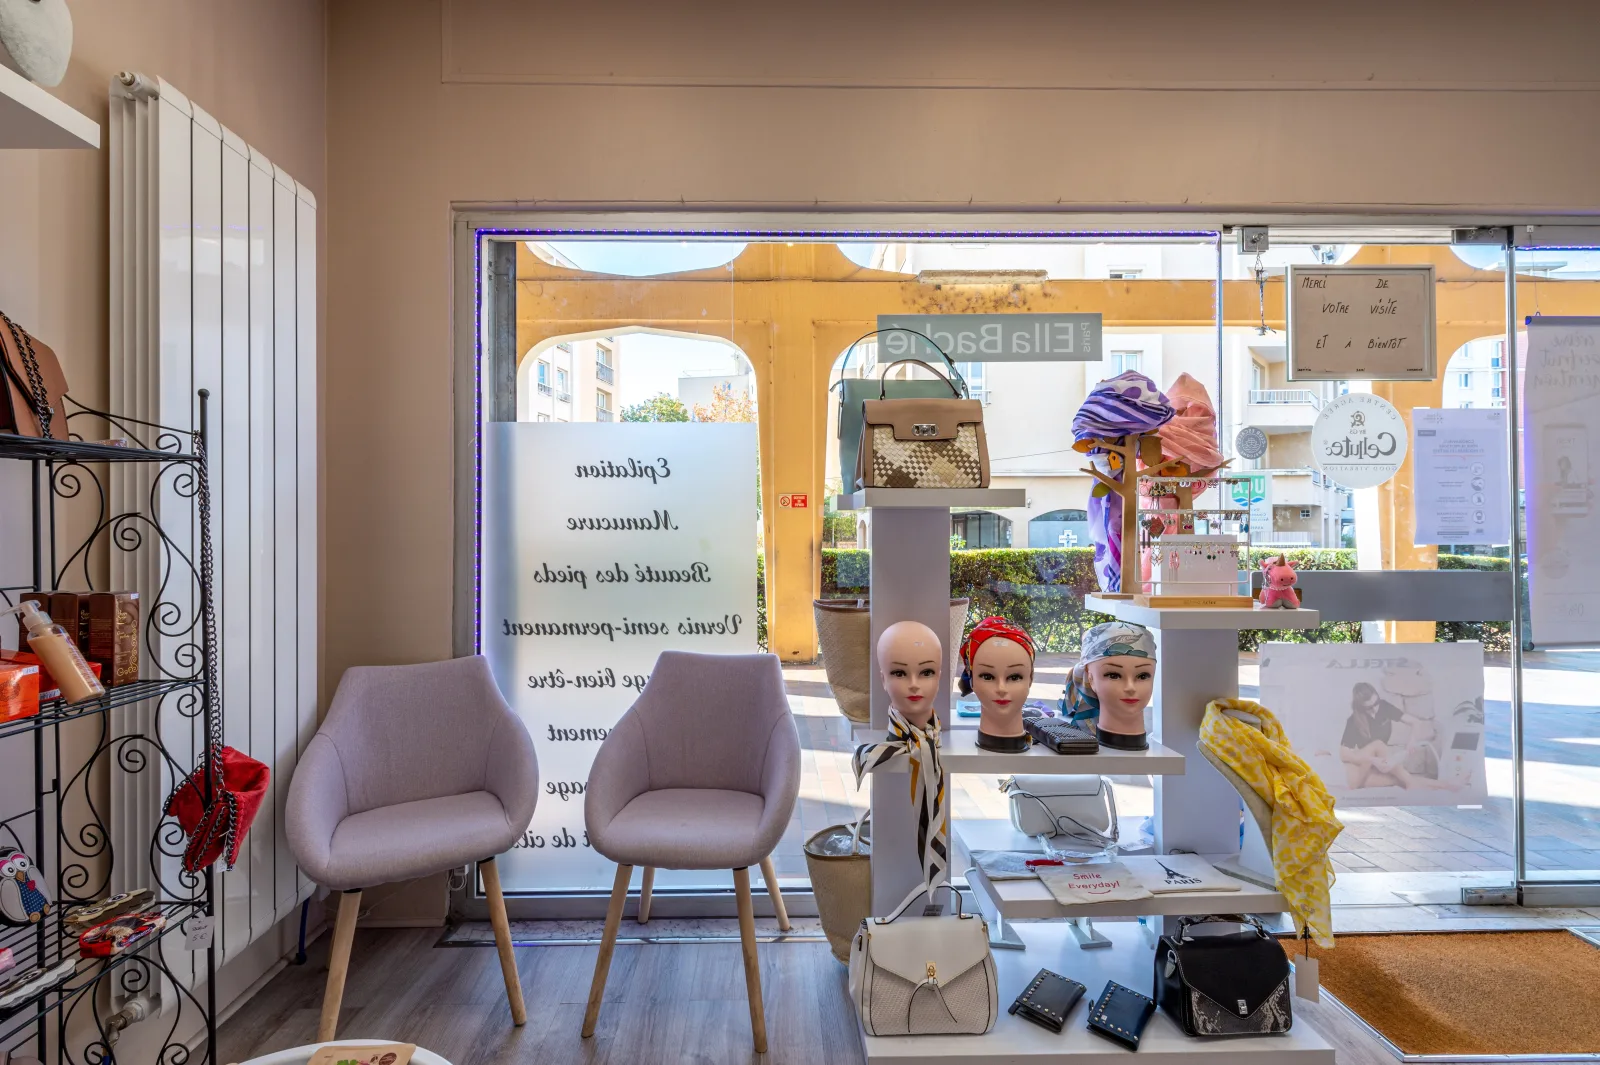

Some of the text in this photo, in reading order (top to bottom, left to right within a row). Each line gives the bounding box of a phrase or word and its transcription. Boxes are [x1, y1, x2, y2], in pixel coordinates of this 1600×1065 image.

[1302, 275, 1389, 289] MERCI DE
[1322, 298, 1398, 315] VOTRE VISITE
[1315, 334, 1329, 349] ET
[1073, 872, 1102, 881] Smile
[1164, 877, 1203, 887] PARIS
[1067, 879, 1121, 891] Everyday!
